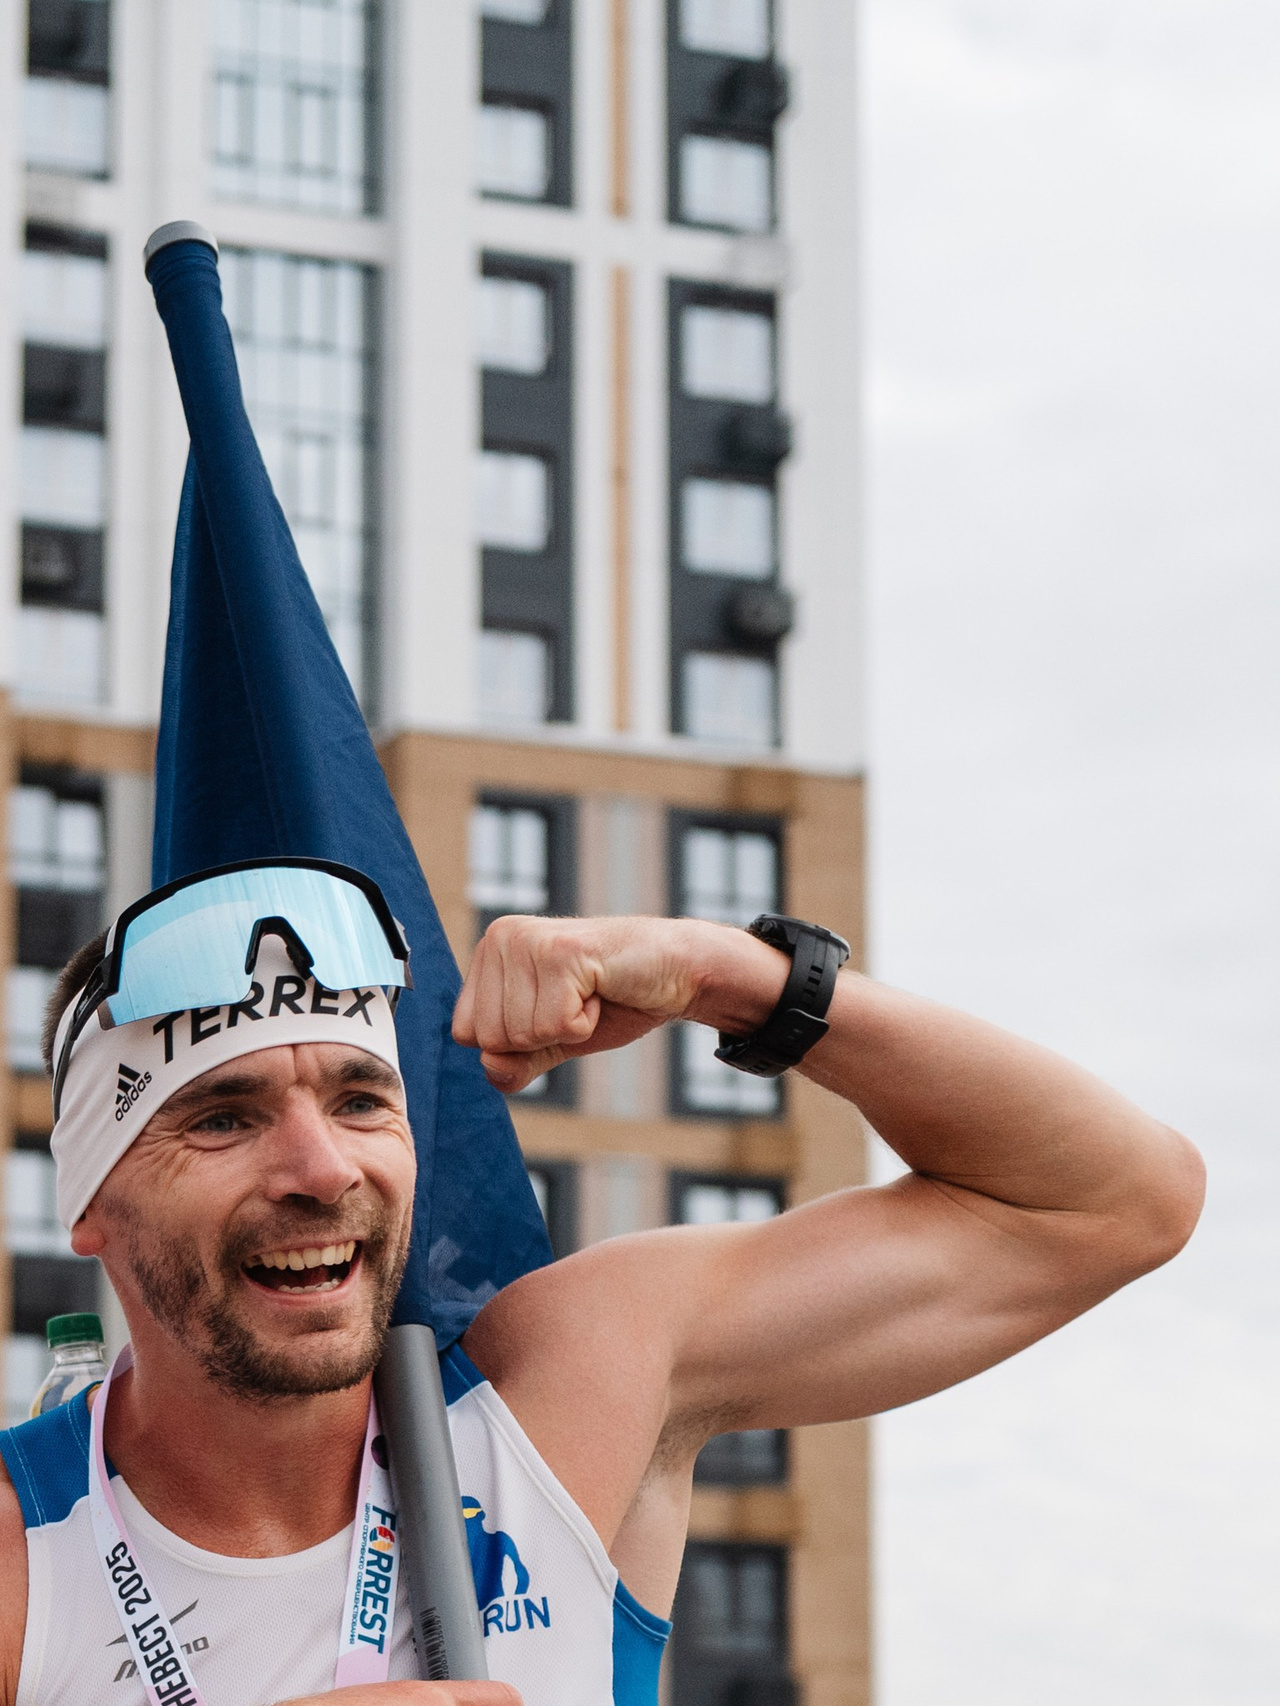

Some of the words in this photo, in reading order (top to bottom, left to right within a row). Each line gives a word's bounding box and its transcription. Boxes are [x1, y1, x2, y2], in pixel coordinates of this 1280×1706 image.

[153, 975, 376, 1064] TERREX
[115, 1070, 153, 1122] adidas
[106, 1541, 152, 1615] 2025
[358, 1505, 397, 1654] FORREST
[483, 1597, 550, 1638] RUN
